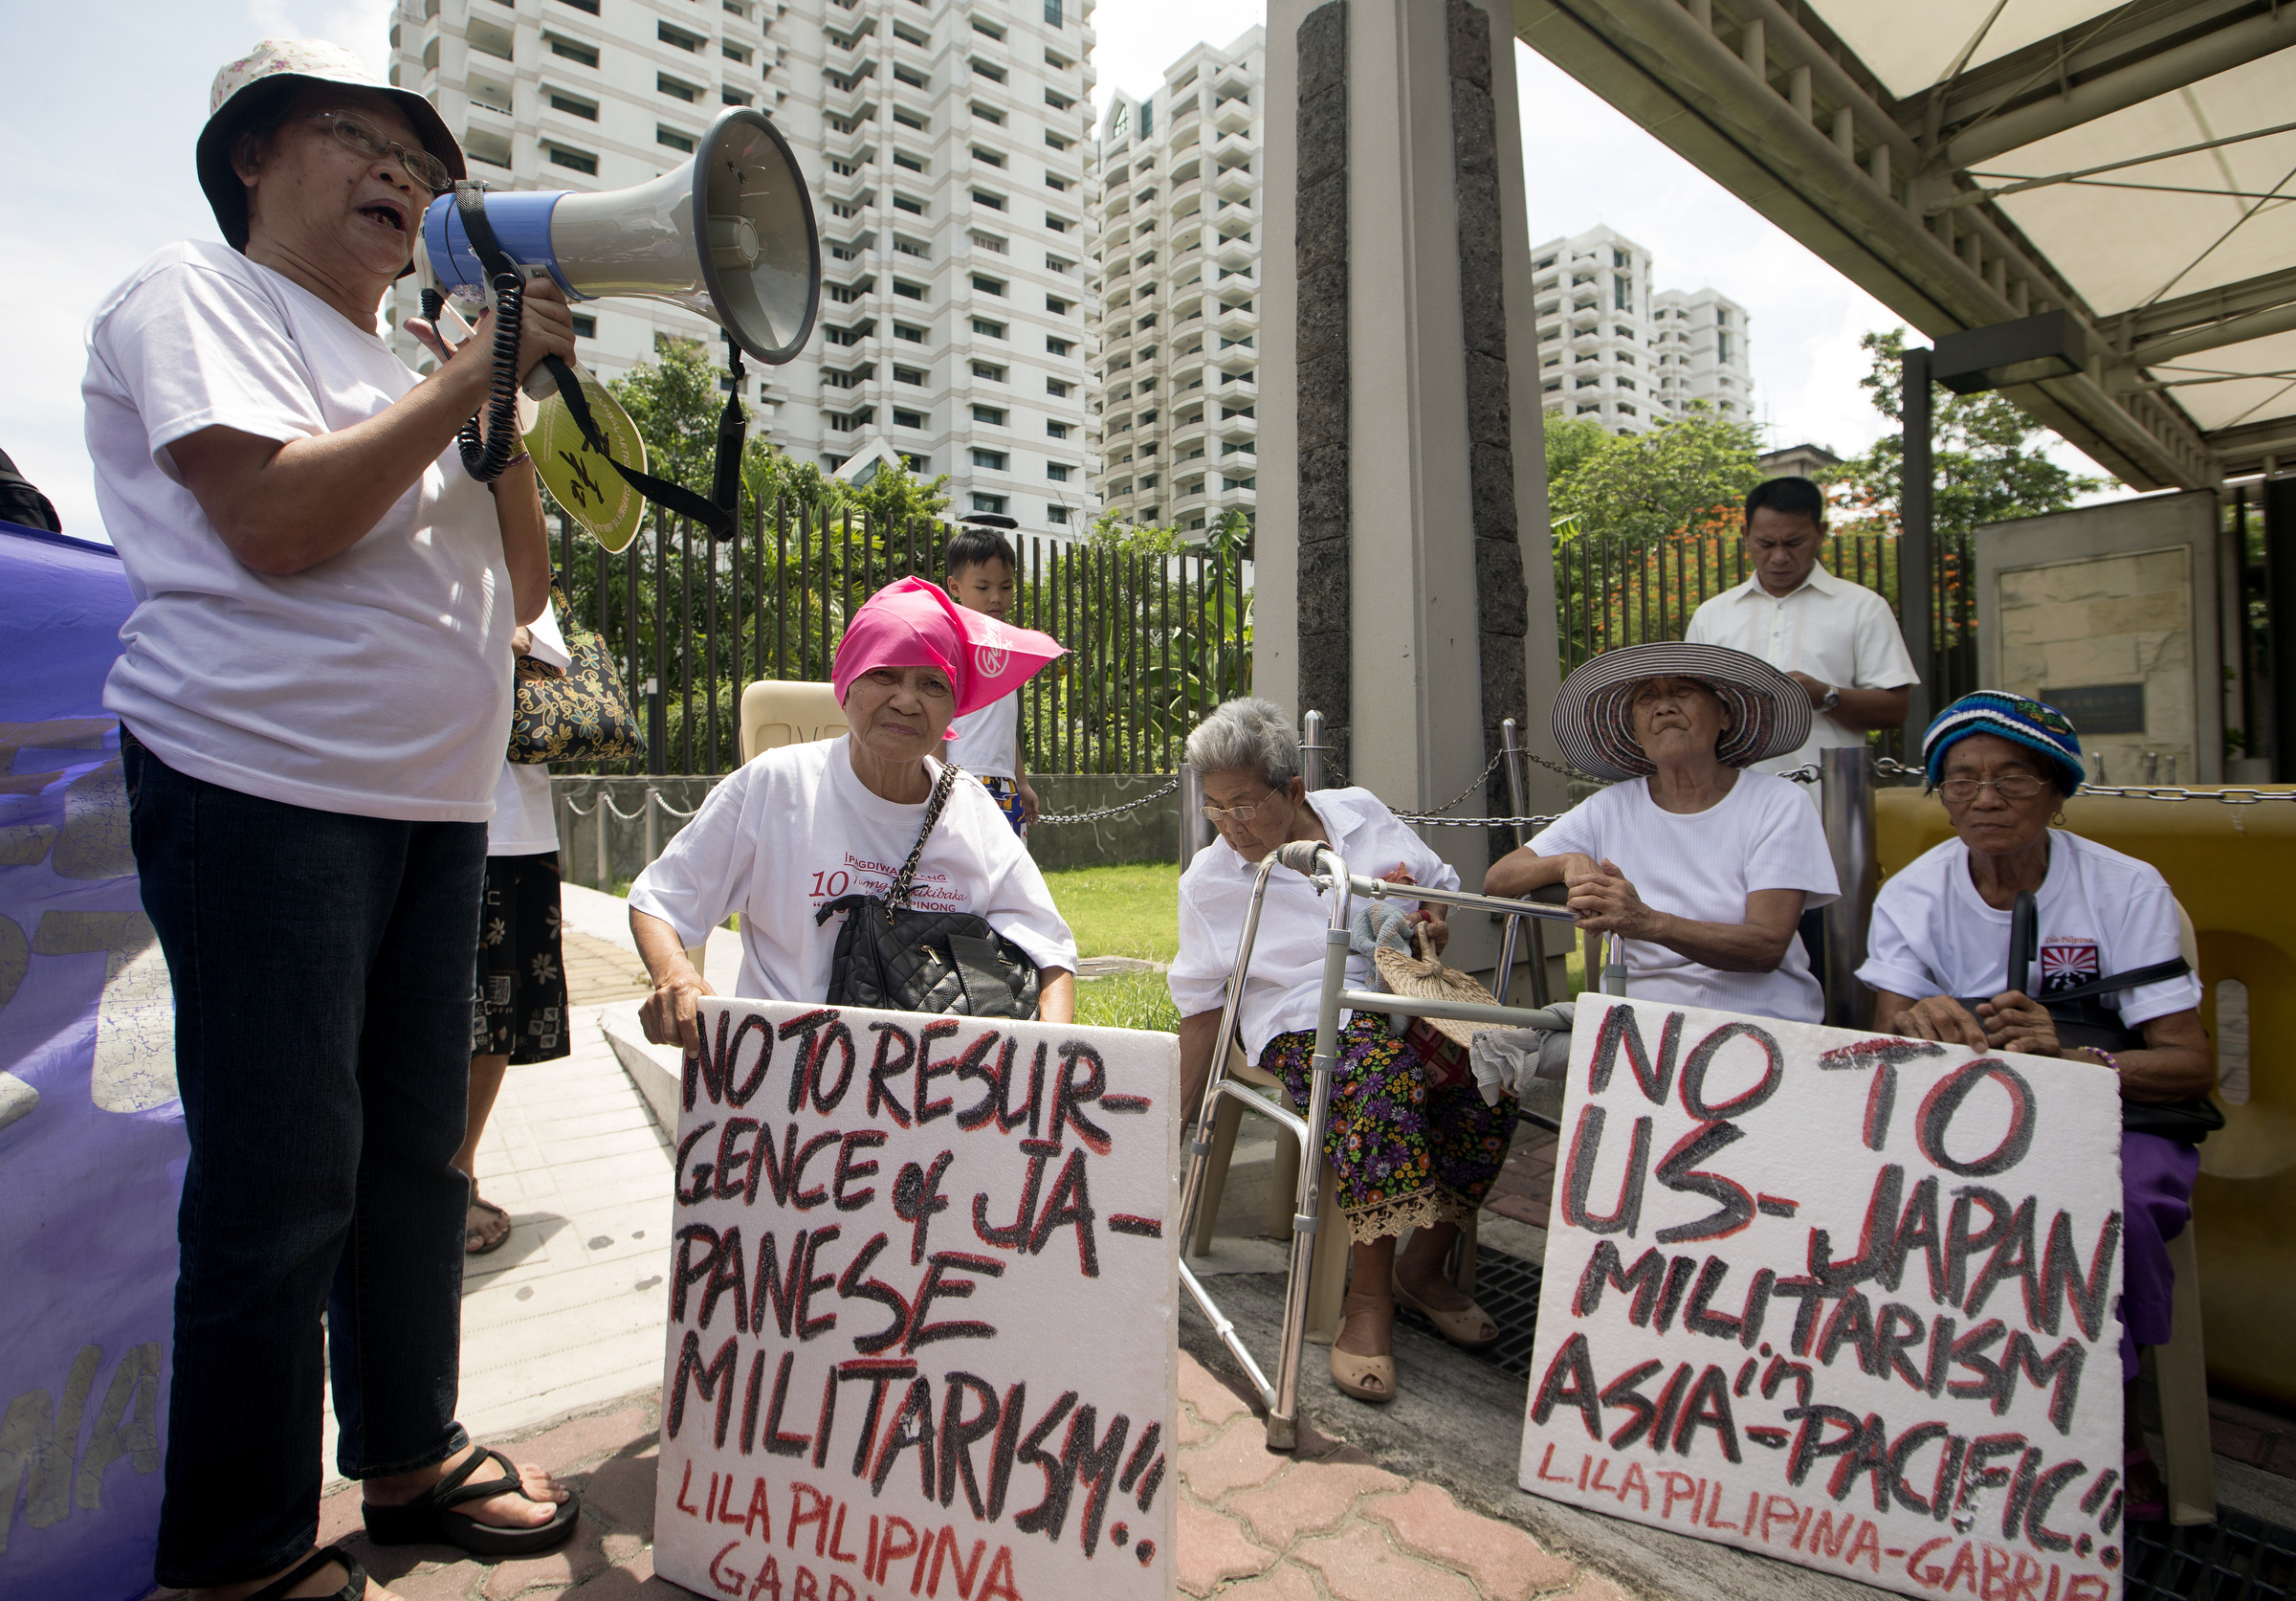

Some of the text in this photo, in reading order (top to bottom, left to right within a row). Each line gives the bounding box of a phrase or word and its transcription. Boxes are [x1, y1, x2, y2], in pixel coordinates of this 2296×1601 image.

[809, 871, 850, 898] 10
[845, 851, 917, 878] IPAGDIWA
[682, 1009, 1152, 1156] NO TO RESUR-
[1588, 1004, 1783, 1122] NO
[1819, 1037, 2037, 1177] TO
[674, 1117, 889, 1212] GENCE
[972, 1139, 1163, 1279] JA-
[672, 1224, 1006, 1357] PANESE
[1572, 1240, 2088, 1435] MILITARISM
[1733, 1343, 1815, 1410] in
[668, 1330, 1165, 1568] MILITARISM!!
[676, 1458, 1022, 1601] LILA PILIPINA
[709, 1540, 874, 1601] GAB
